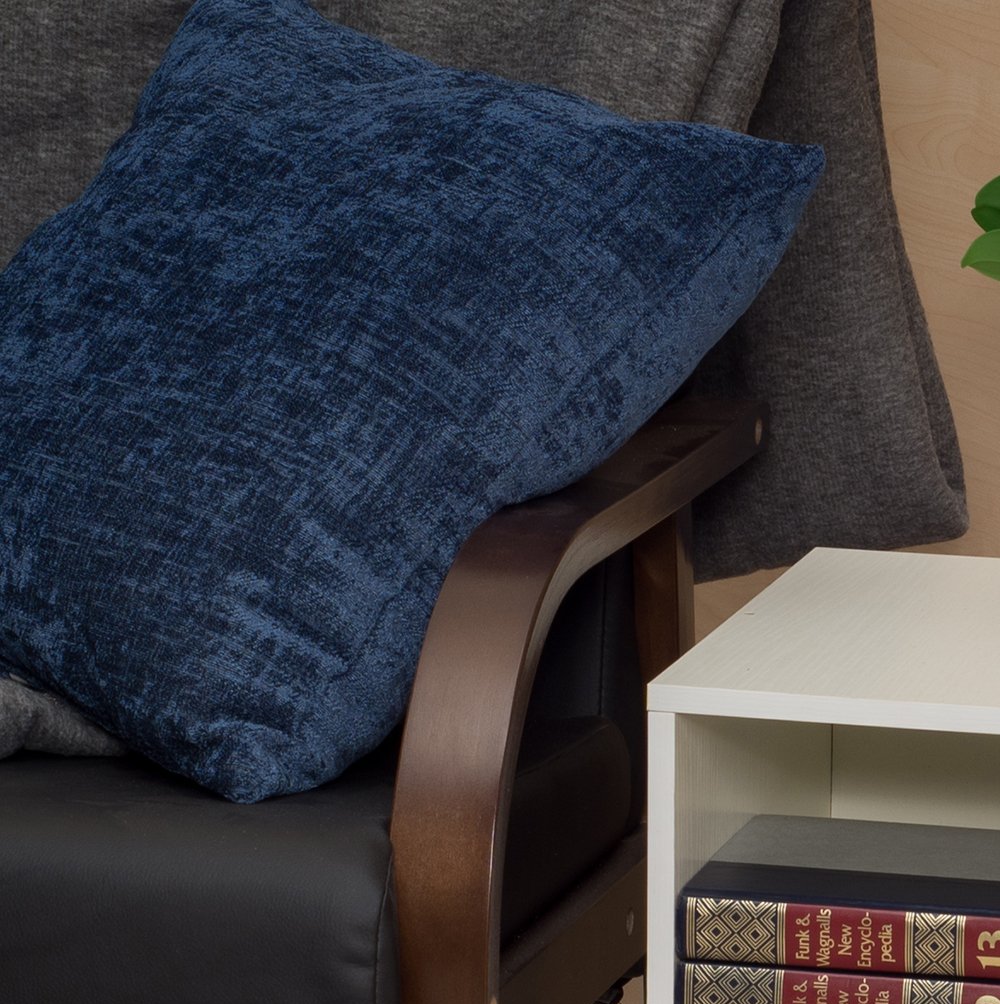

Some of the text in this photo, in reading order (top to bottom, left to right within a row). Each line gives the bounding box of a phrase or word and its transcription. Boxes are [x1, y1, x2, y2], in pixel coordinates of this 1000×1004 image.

[795, 913, 811, 960] Funk &
[816, 908, 835, 967] Wagnalls
[838, 924, 852, 956] New
[857, 911, 875, 967] Encyclo-
[878, 923, 896, 962] pedia
[792, 980, 808, 992] &
